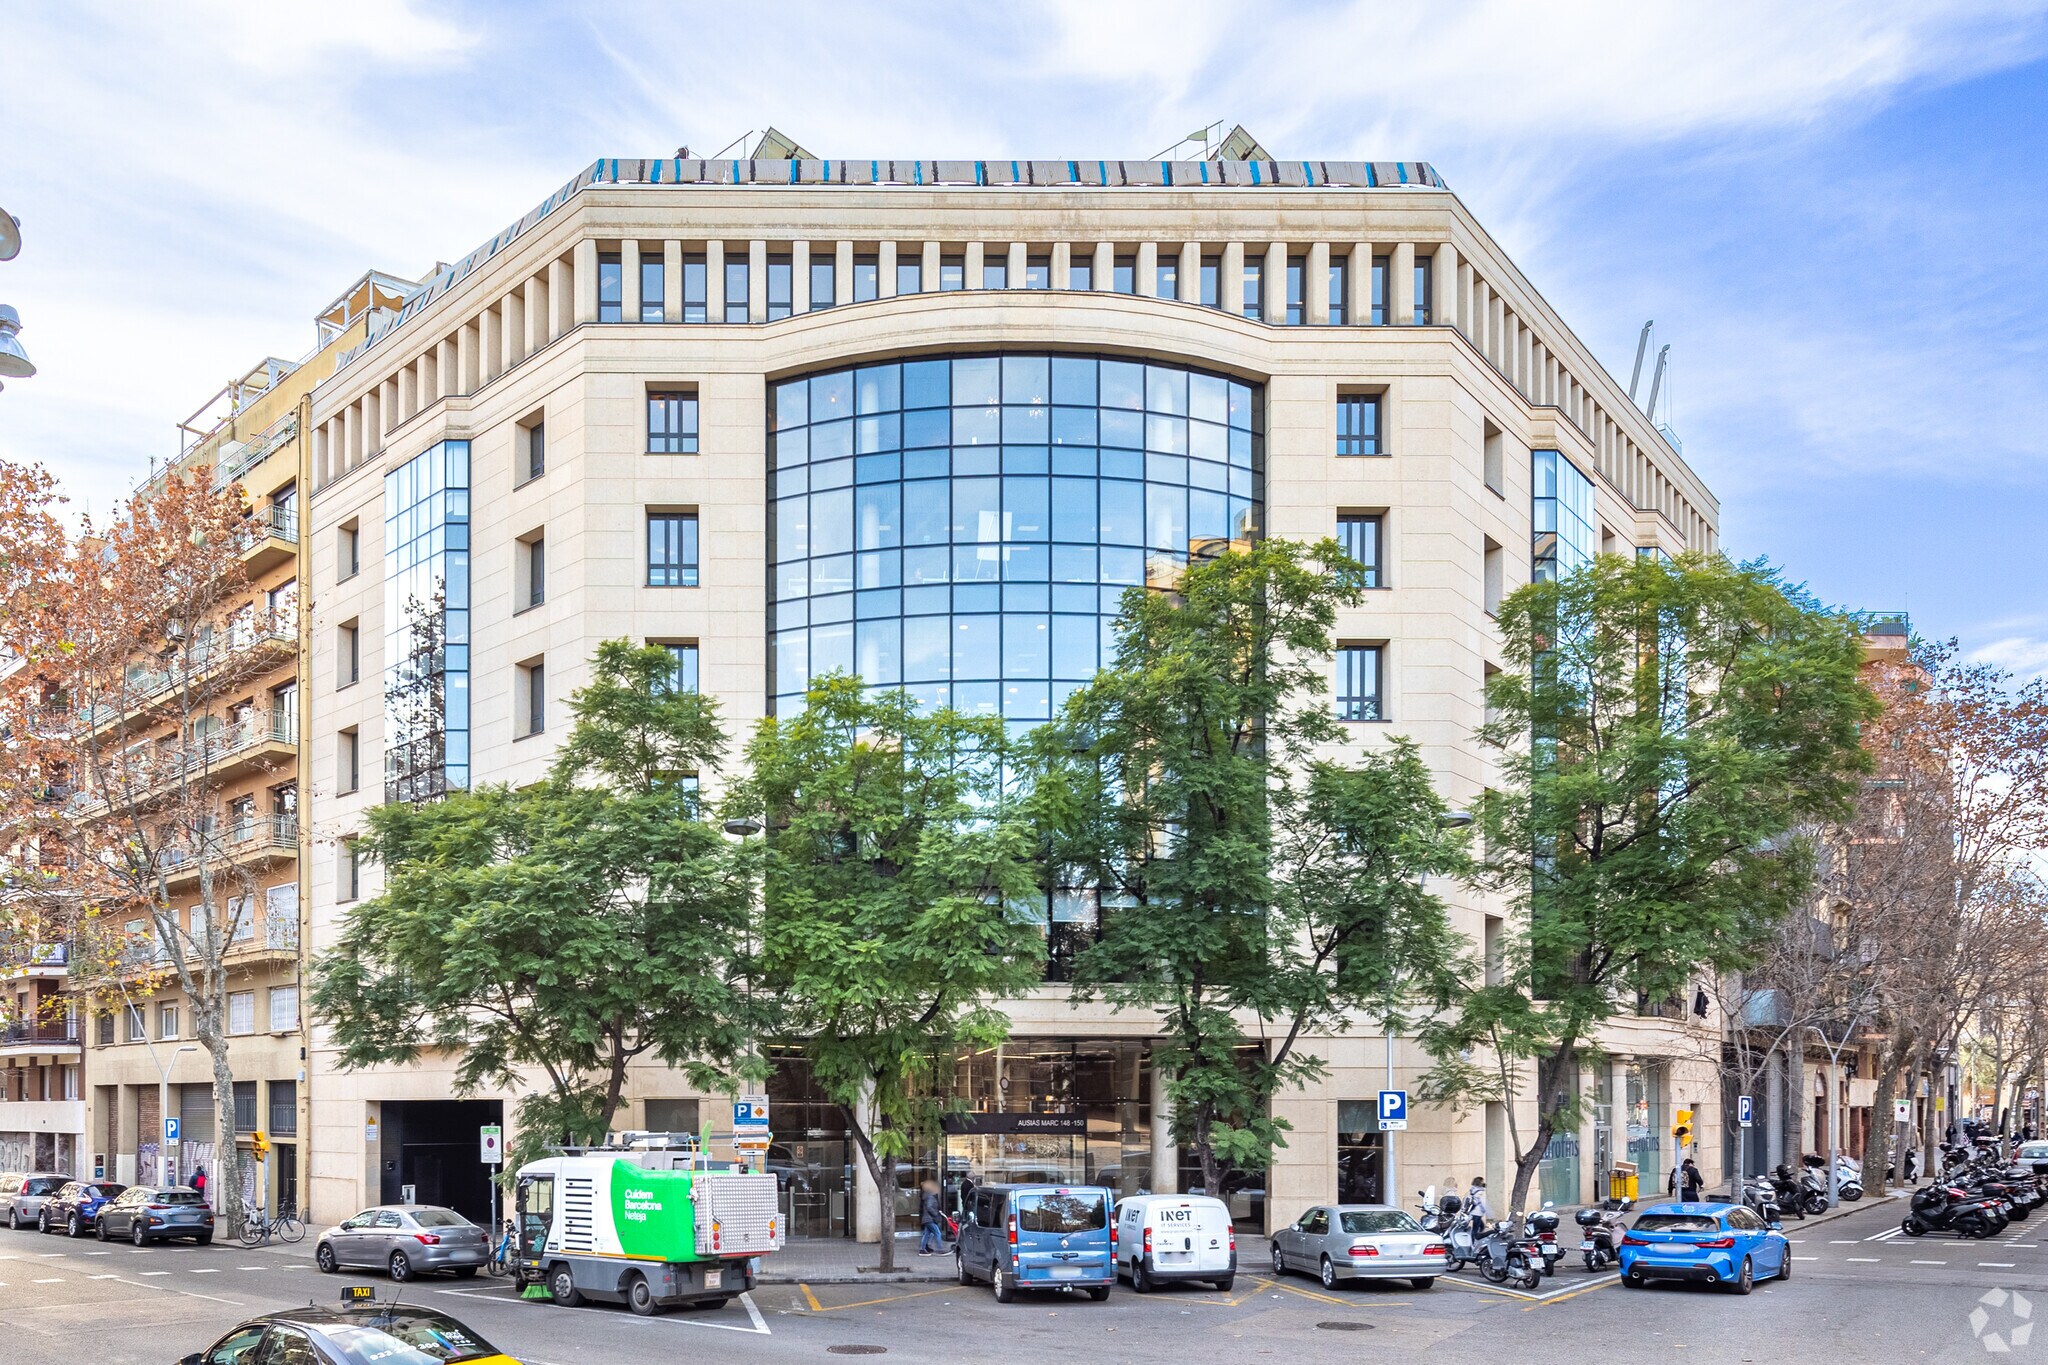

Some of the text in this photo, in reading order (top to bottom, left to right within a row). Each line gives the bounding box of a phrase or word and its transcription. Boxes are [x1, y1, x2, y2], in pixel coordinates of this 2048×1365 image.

[737, 1104, 748, 1117] P
[1383, 1093, 1402, 1117] P
[1741, 1099, 1749, 1119] P
[167, 1119, 177, 1137] P
[1018, 1119, 1040, 1127] AUSIAS
[1041, 1119, 1059, 1127] MARC
[1060, 1119, 1071, 1127] 148
[1543, 1135, 1580, 1160] urofins
[625, 1189, 653, 1199] Cuidem
[625, 1200, 662, 1210] Barcelona
[625, 1210, 646, 1223] Neteja
[353, 1287, 370, 1297] TAXI
